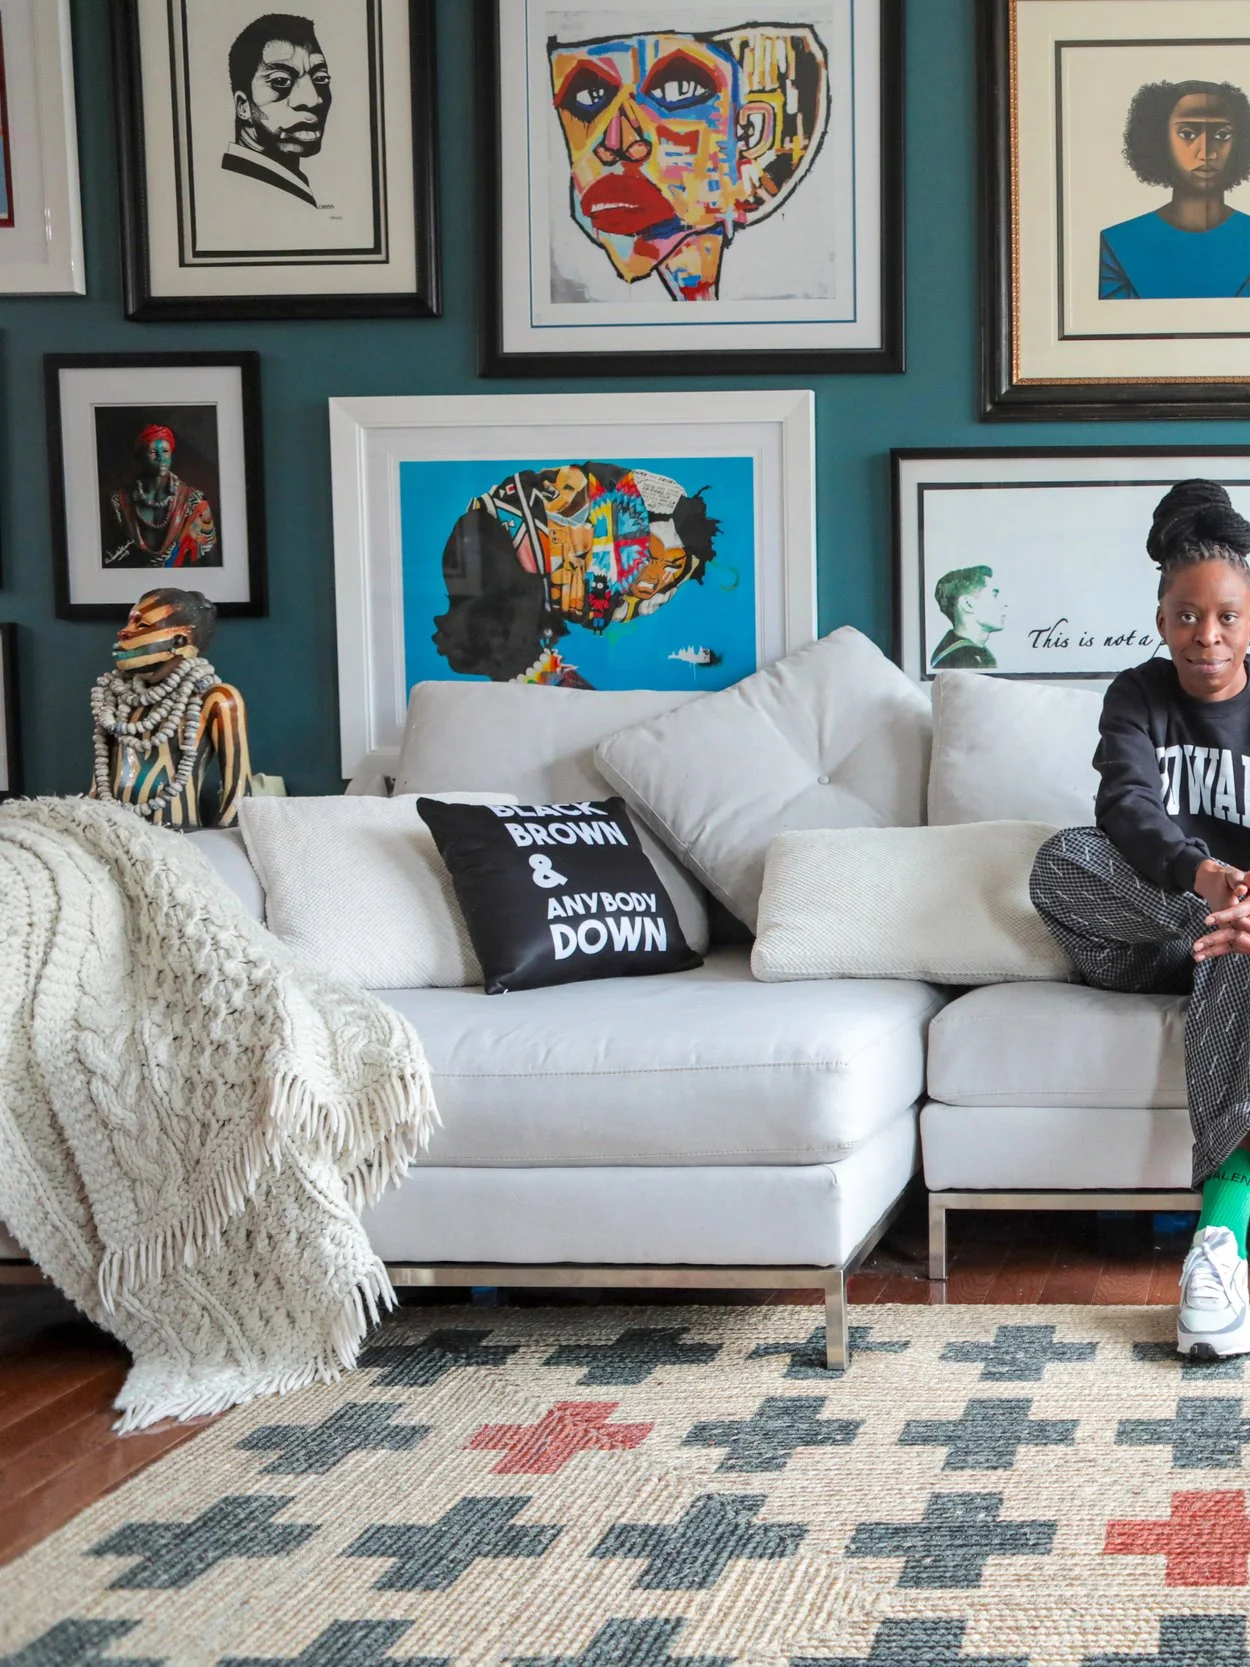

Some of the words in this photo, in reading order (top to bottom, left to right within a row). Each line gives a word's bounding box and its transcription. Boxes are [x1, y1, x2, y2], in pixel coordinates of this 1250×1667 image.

[1028, 617, 1069, 650] This
[1078, 631, 1094, 649] is
[1103, 630, 1136, 647] not
[1138, 635, 1154, 647] a
[504, 821, 628, 847] BROWN
[528, 853, 568, 889] &
[547, 892, 656, 920] ANYBODY
[549, 916, 667, 961] DOWN
